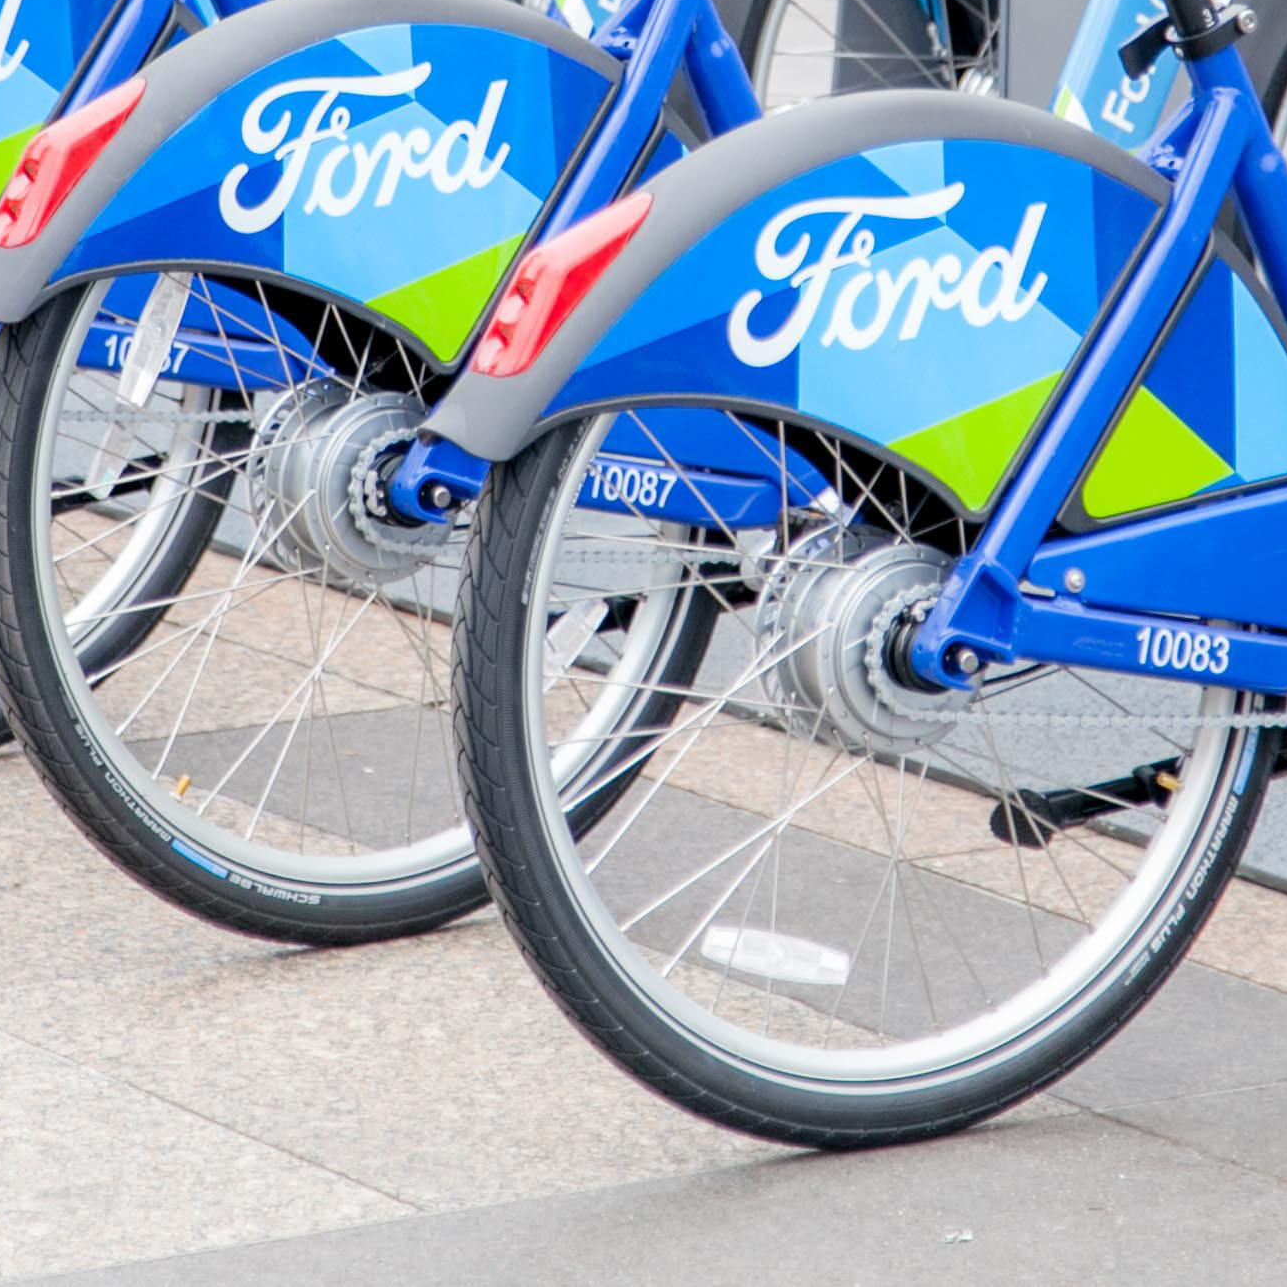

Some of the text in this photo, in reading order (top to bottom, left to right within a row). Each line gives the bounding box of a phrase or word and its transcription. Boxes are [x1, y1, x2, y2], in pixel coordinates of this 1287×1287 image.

[1202, 8, 1214, 27] 3
[218, 60, 511, 234] Ford
[727, 182, 1048, 368] Ford
[105, 334, 190, 374] 107
[589, 464, 678, 508] 10087
[1137, 627, 1231, 675] 10083
[73, 722, 322, 906] SCHWALBE MARATHON PLUS
[1149, 794, 1240, 955] MARATHON PLUS
